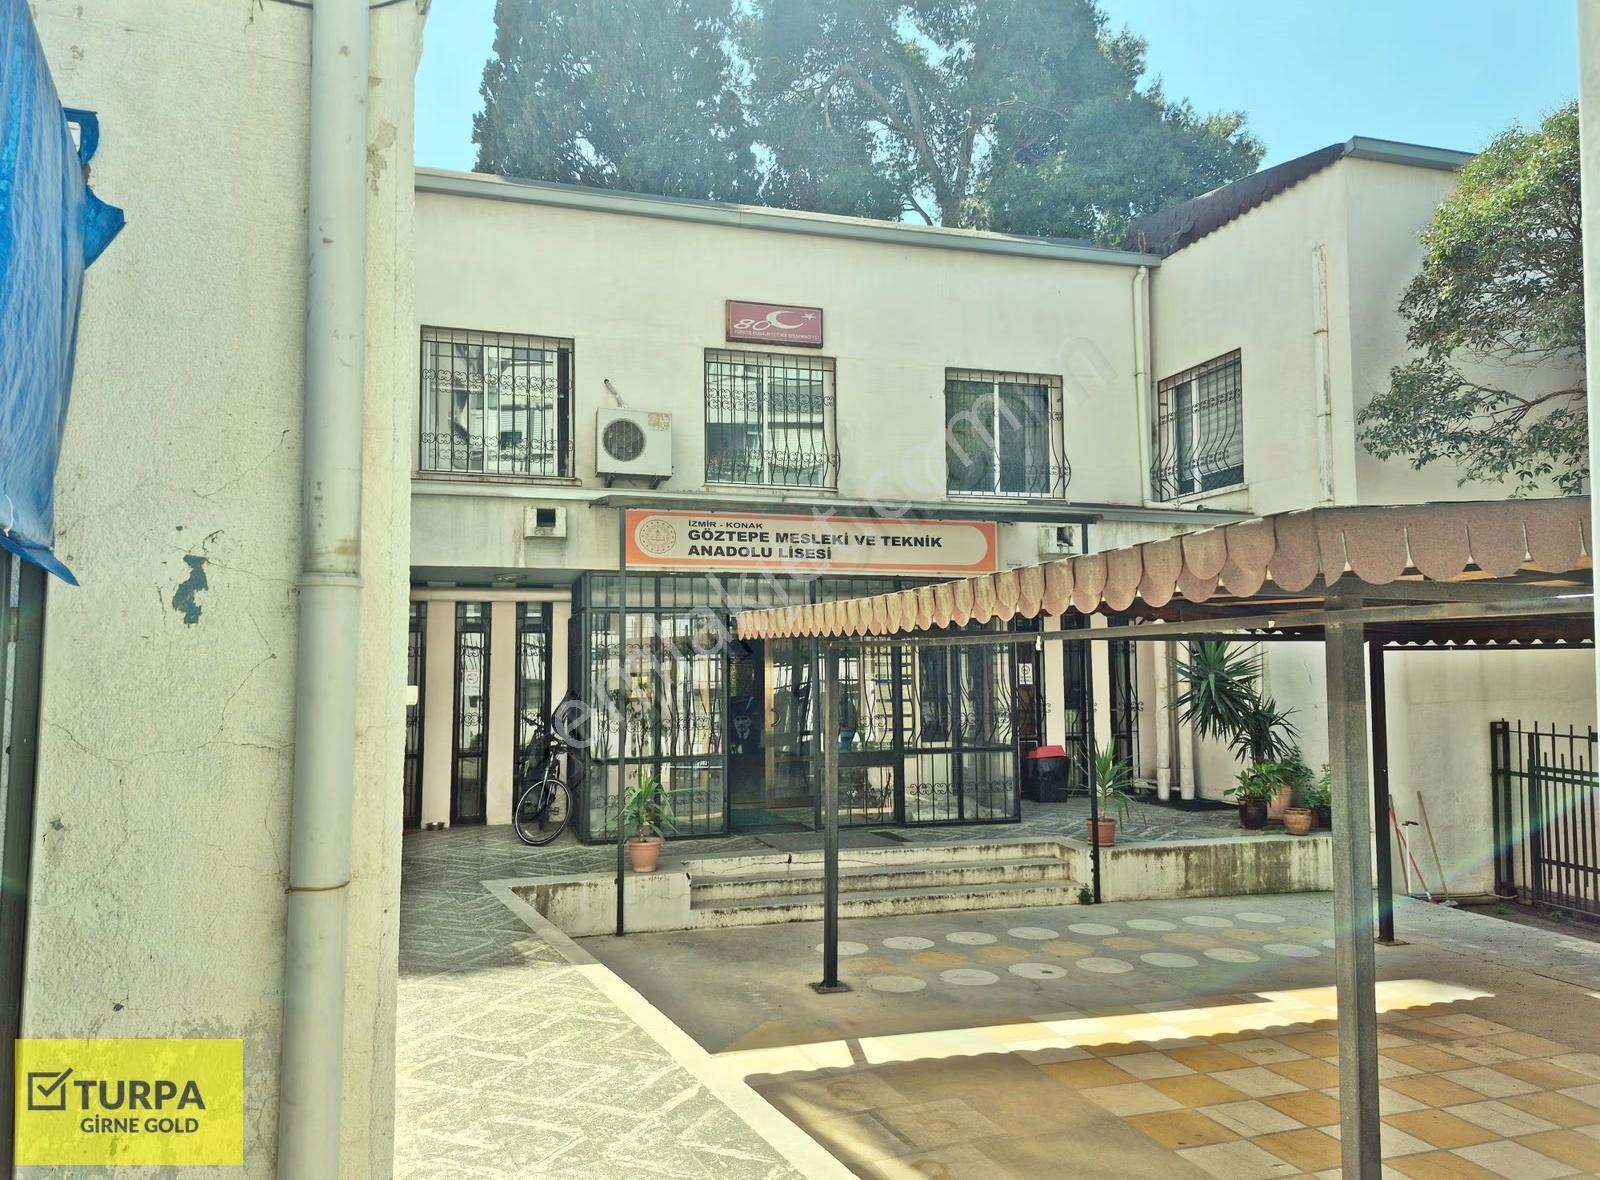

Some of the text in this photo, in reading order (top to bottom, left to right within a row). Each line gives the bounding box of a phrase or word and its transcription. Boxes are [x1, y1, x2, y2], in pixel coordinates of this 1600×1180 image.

[688, 520, 717, 528] İZMİR
[688, 528, 943, 548] GÖZTEPE MESLEKİ VE TEKNİK
[688, 545, 832, 559] ANADOLU LİSESİ
